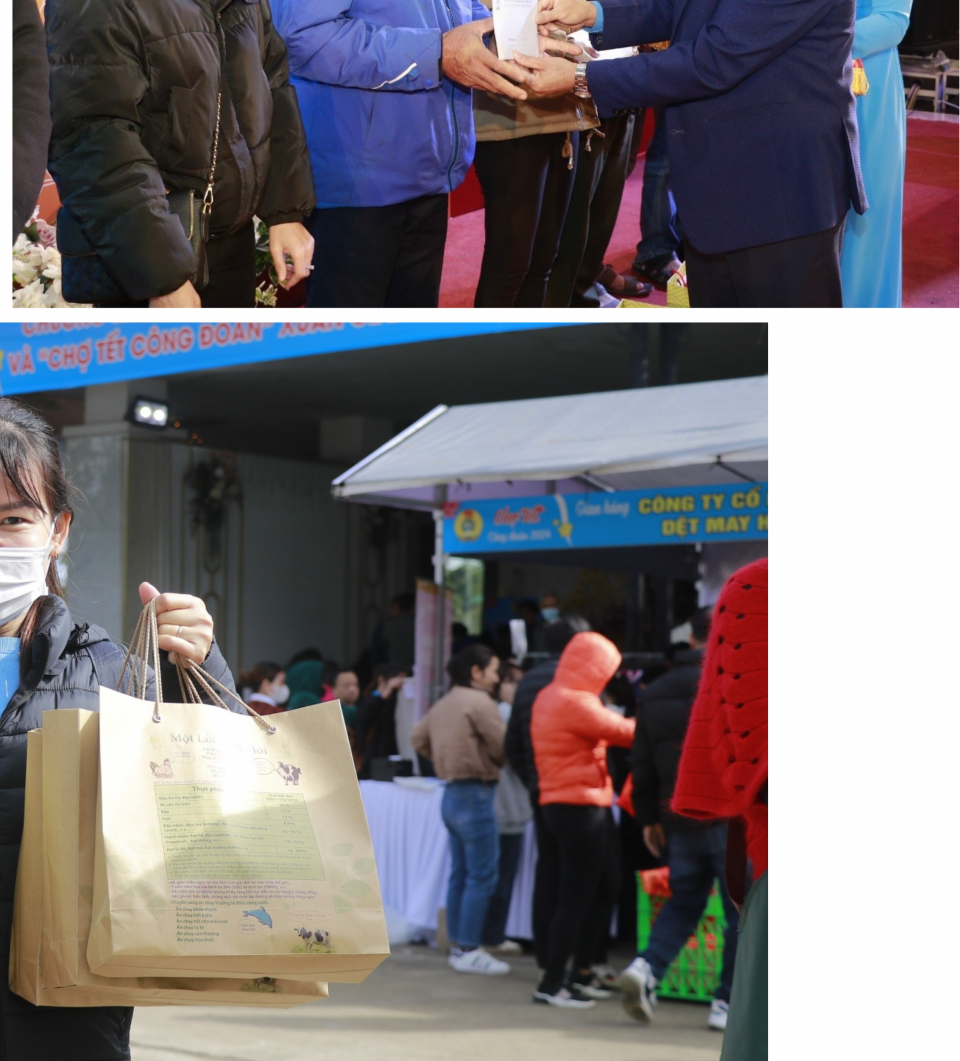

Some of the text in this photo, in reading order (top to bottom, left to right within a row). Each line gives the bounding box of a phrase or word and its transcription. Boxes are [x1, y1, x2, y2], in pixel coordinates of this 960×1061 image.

[8, 345, 35, 375] VÀ
[95, 329, 125, 364] TẾT
[130, 325, 193, 358] CÔNG
[638, 486, 762, 514] CÔNG TY CỔ
[662, 518, 700, 539] DỆT
[705, 516, 750, 534] MAY
